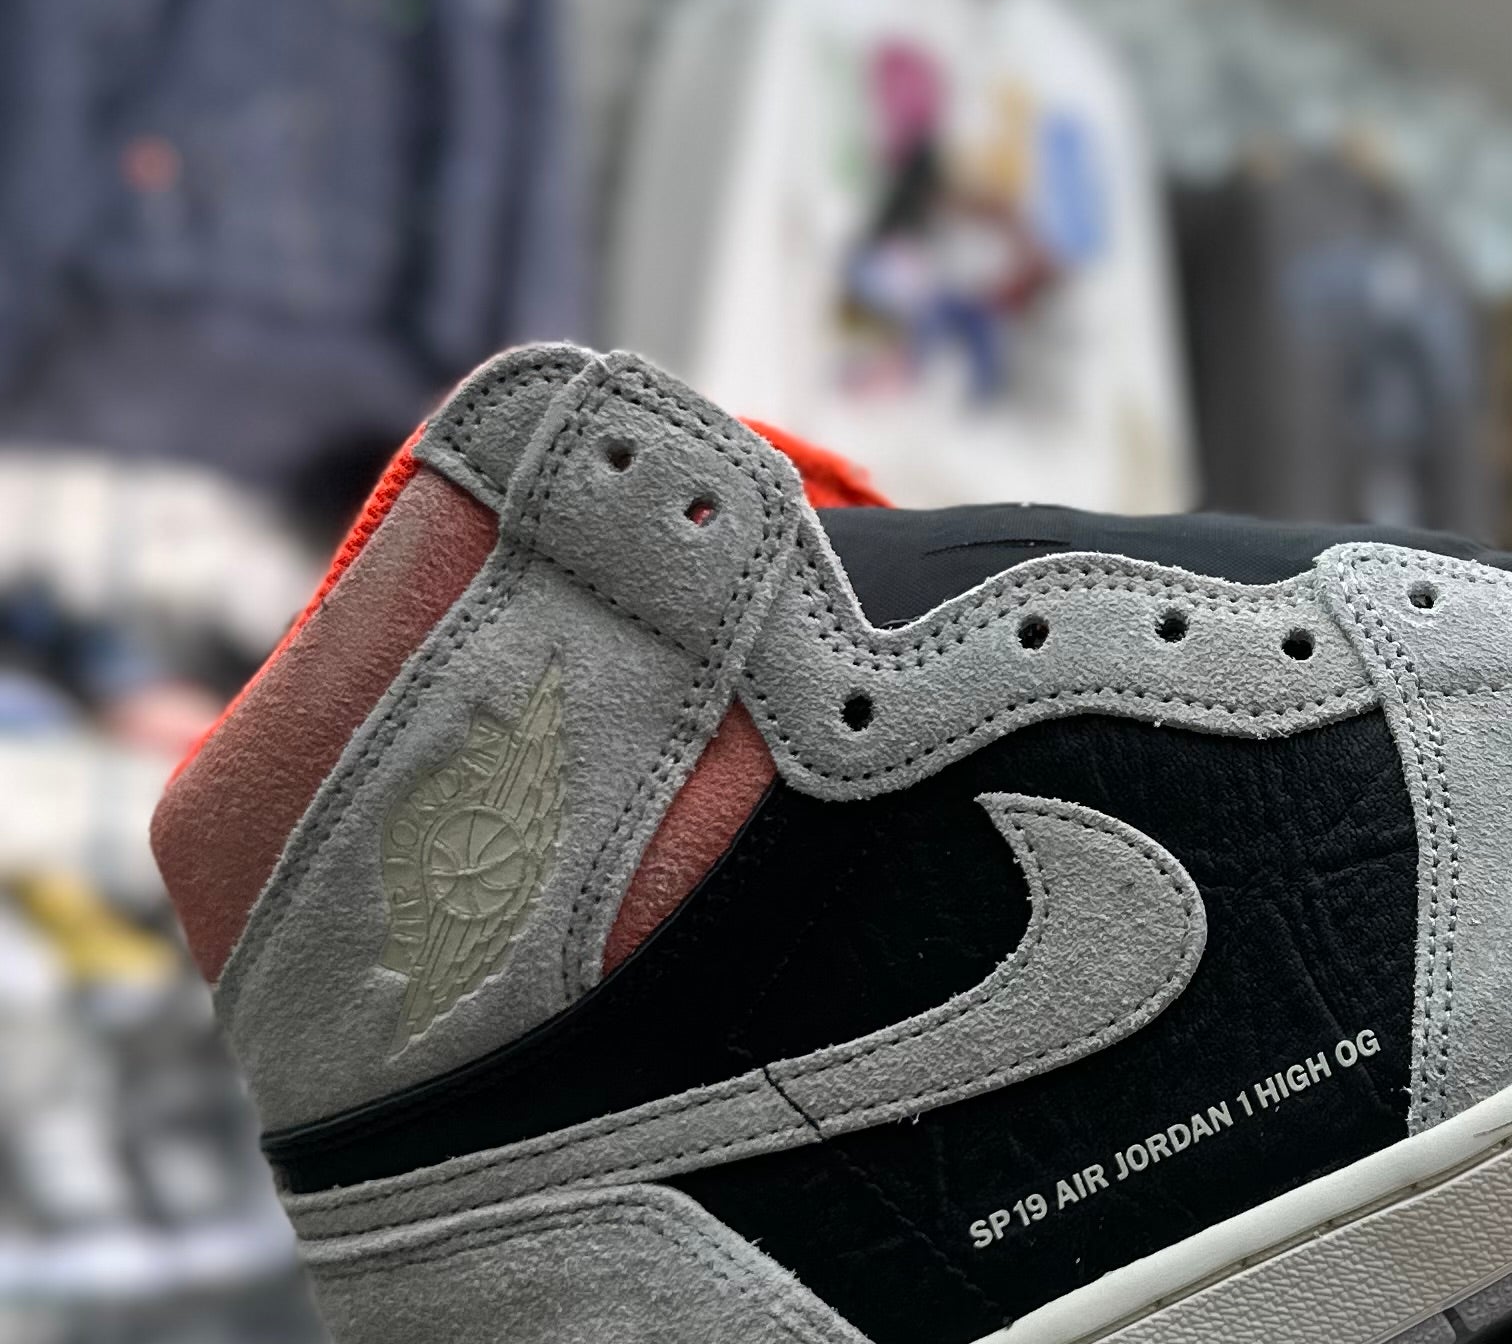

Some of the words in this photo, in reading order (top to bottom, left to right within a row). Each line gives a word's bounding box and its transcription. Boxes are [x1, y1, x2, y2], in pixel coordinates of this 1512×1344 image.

[1056, 1163, 1110, 1211] AIR
[1114, 1100, 1234, 1181] JORDAN
[1236, 1090, 1254, 1117] 1
[1253, 1051, 1332, 1109] HIGH
[1334, 1028, 1382, 1068] OG
